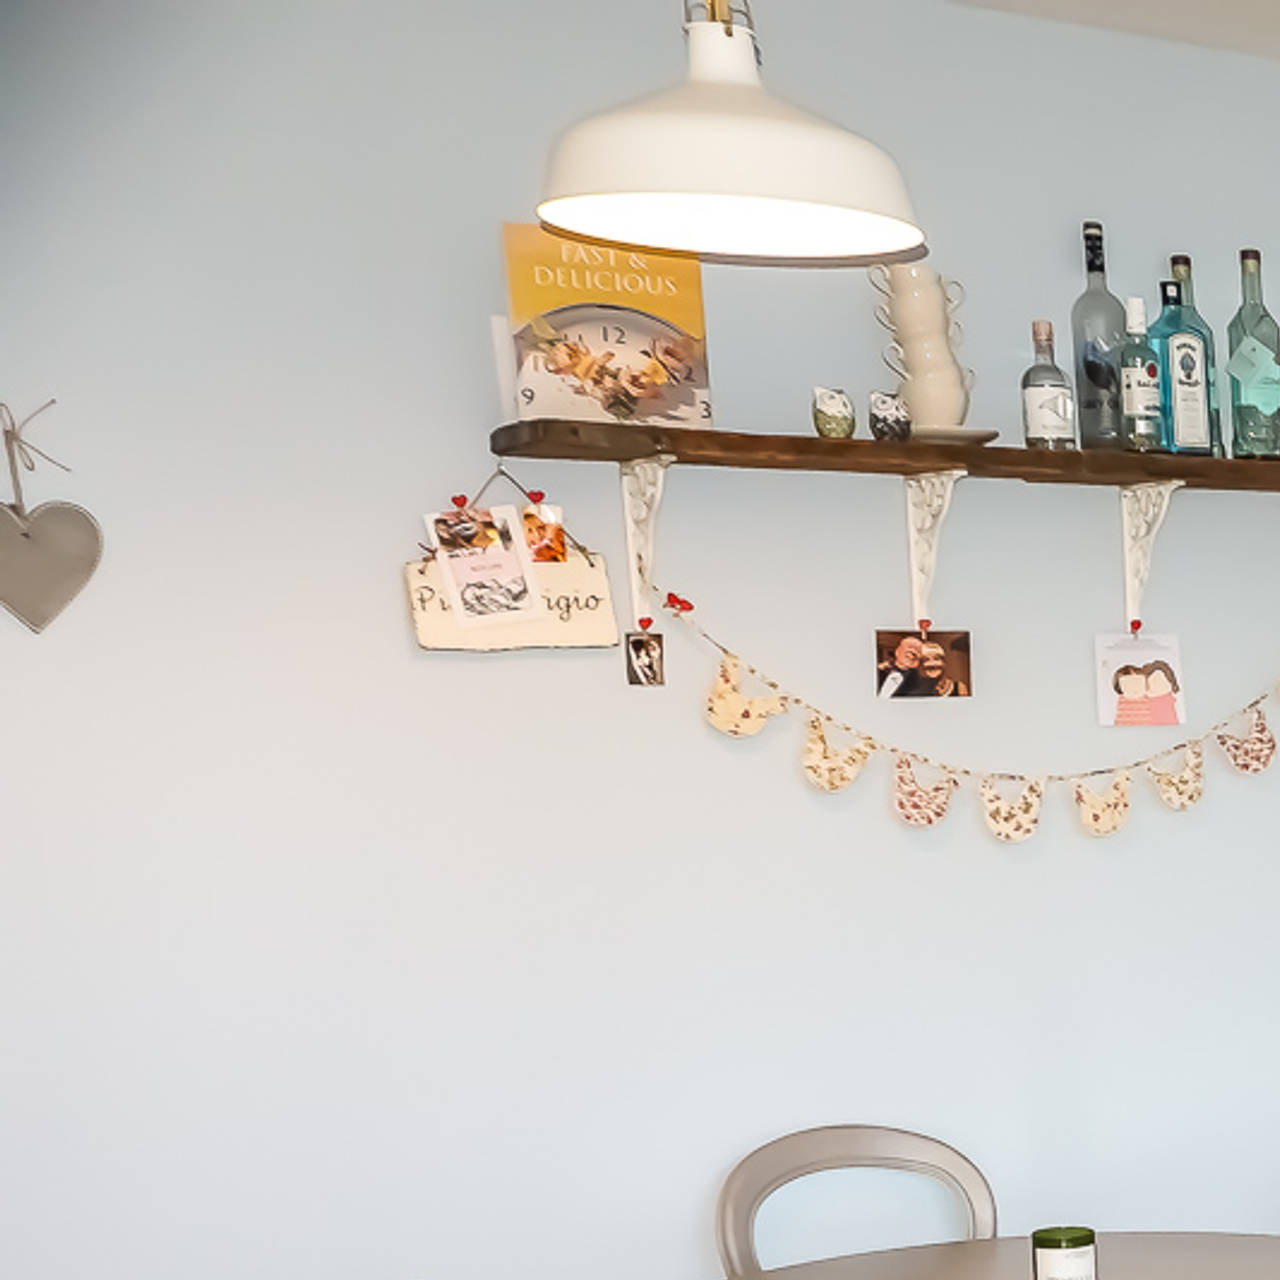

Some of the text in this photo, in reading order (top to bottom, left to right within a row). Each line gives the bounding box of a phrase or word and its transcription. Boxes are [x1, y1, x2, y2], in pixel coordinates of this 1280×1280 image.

[560, 243, 648, 270] FAST &
[533, 265, 678, 297] DELICIOUS
[602, 325, 627, 345] 12
[521, 388, 535, 406] 9
[700, 400, 712, 419] 3
[542, 588, 603, 622] igio
